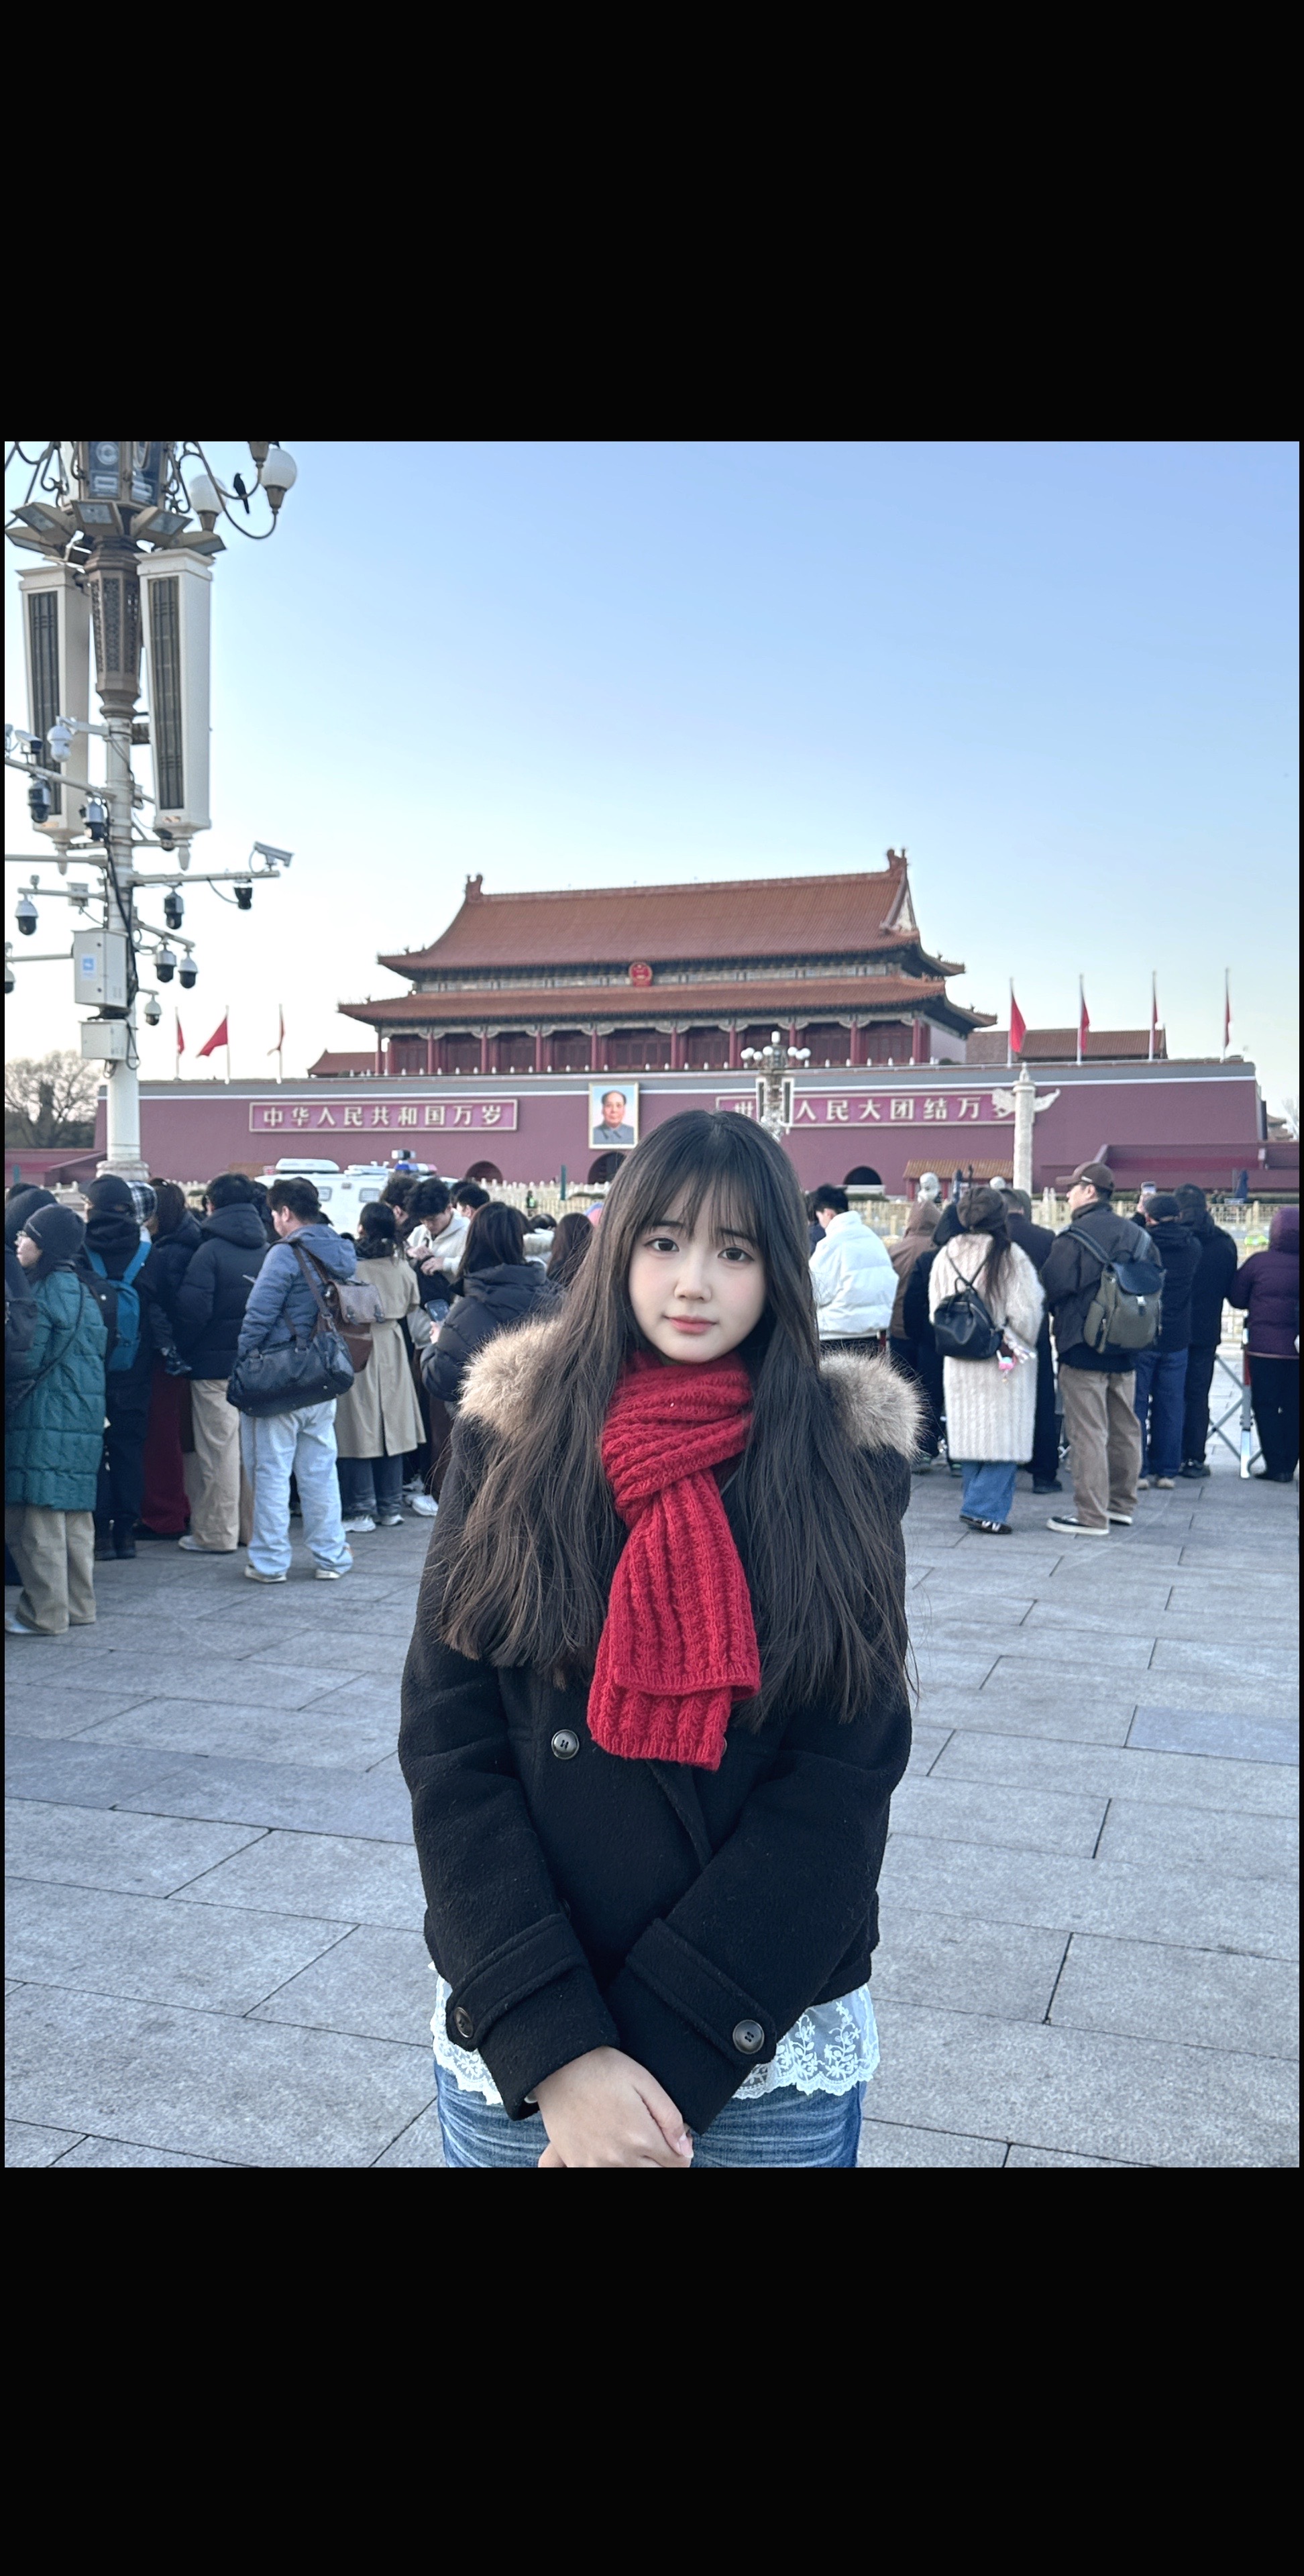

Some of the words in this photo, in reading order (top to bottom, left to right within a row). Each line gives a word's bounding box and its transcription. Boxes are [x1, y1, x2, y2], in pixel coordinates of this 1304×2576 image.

[264, 1105, 501, 1126] 中华人民共和国万岁
[734, 1096, 1014, 1120] 世人民大团结万
